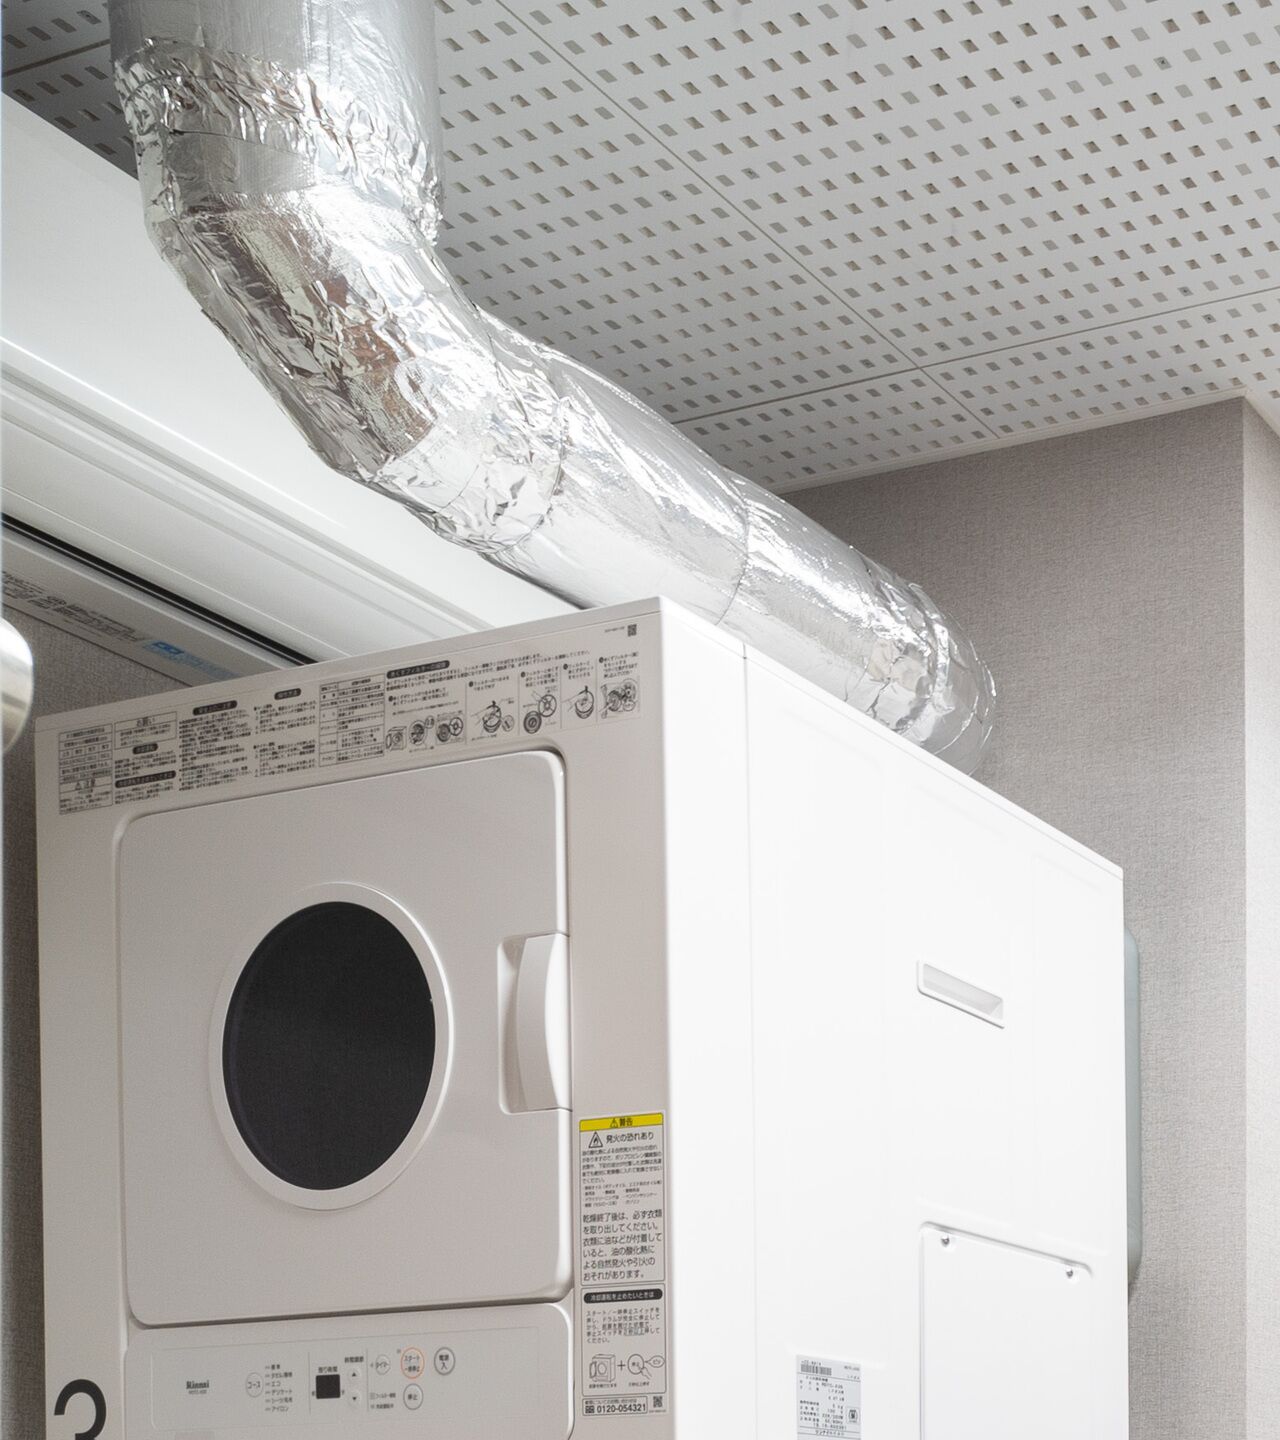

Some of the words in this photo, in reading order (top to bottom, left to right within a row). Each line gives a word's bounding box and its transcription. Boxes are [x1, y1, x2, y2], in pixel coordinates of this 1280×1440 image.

[619, 1117, 634, 1127] 警告
[605, 1131, 655, 1144] 発火の恐れあり
[582, 1209, 663, 1223] 乾燥終了後は、必ず衣類
[582, 1222, 659, 1235] を取り出してください。
[582, 1233, 663, 1247] 衣類に油などが付着して
[583, 1270, 645, 1281] おそれがあります。
[186, 1380, 210, 1390] Rinnai
[596, 1403, 647, 1414] 0120-054321
